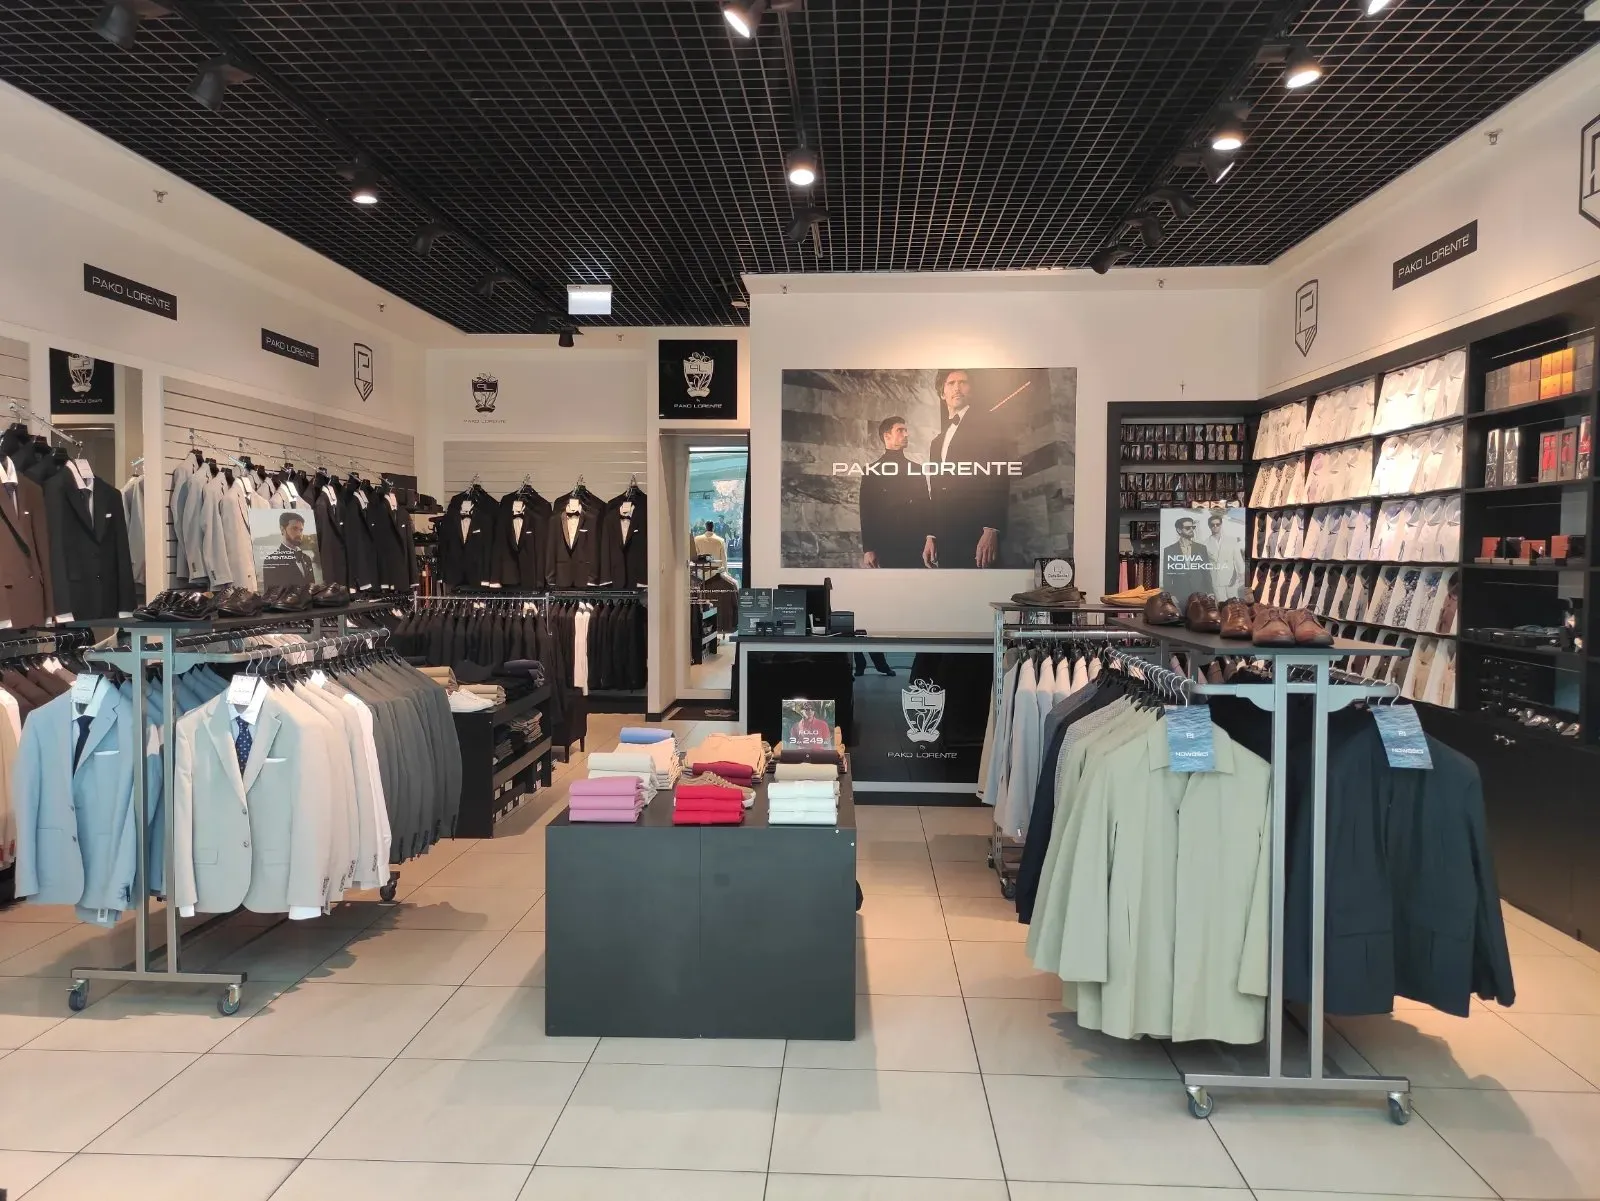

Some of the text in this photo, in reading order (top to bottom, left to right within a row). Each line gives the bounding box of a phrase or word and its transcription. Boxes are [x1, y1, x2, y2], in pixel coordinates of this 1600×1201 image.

[1398, 234, 1470, 279] PAKO LORENTE
[92, 276, 171, 311] PAKO LORENTE
[265, 337, 315, 360] PAKO LORENTE
[832, 462, 1023, 476] PAKO LORENTE
[1167, 554, 1204, 562] NOWA
[1167, 562, 1230, 570] KOLEKCJA
